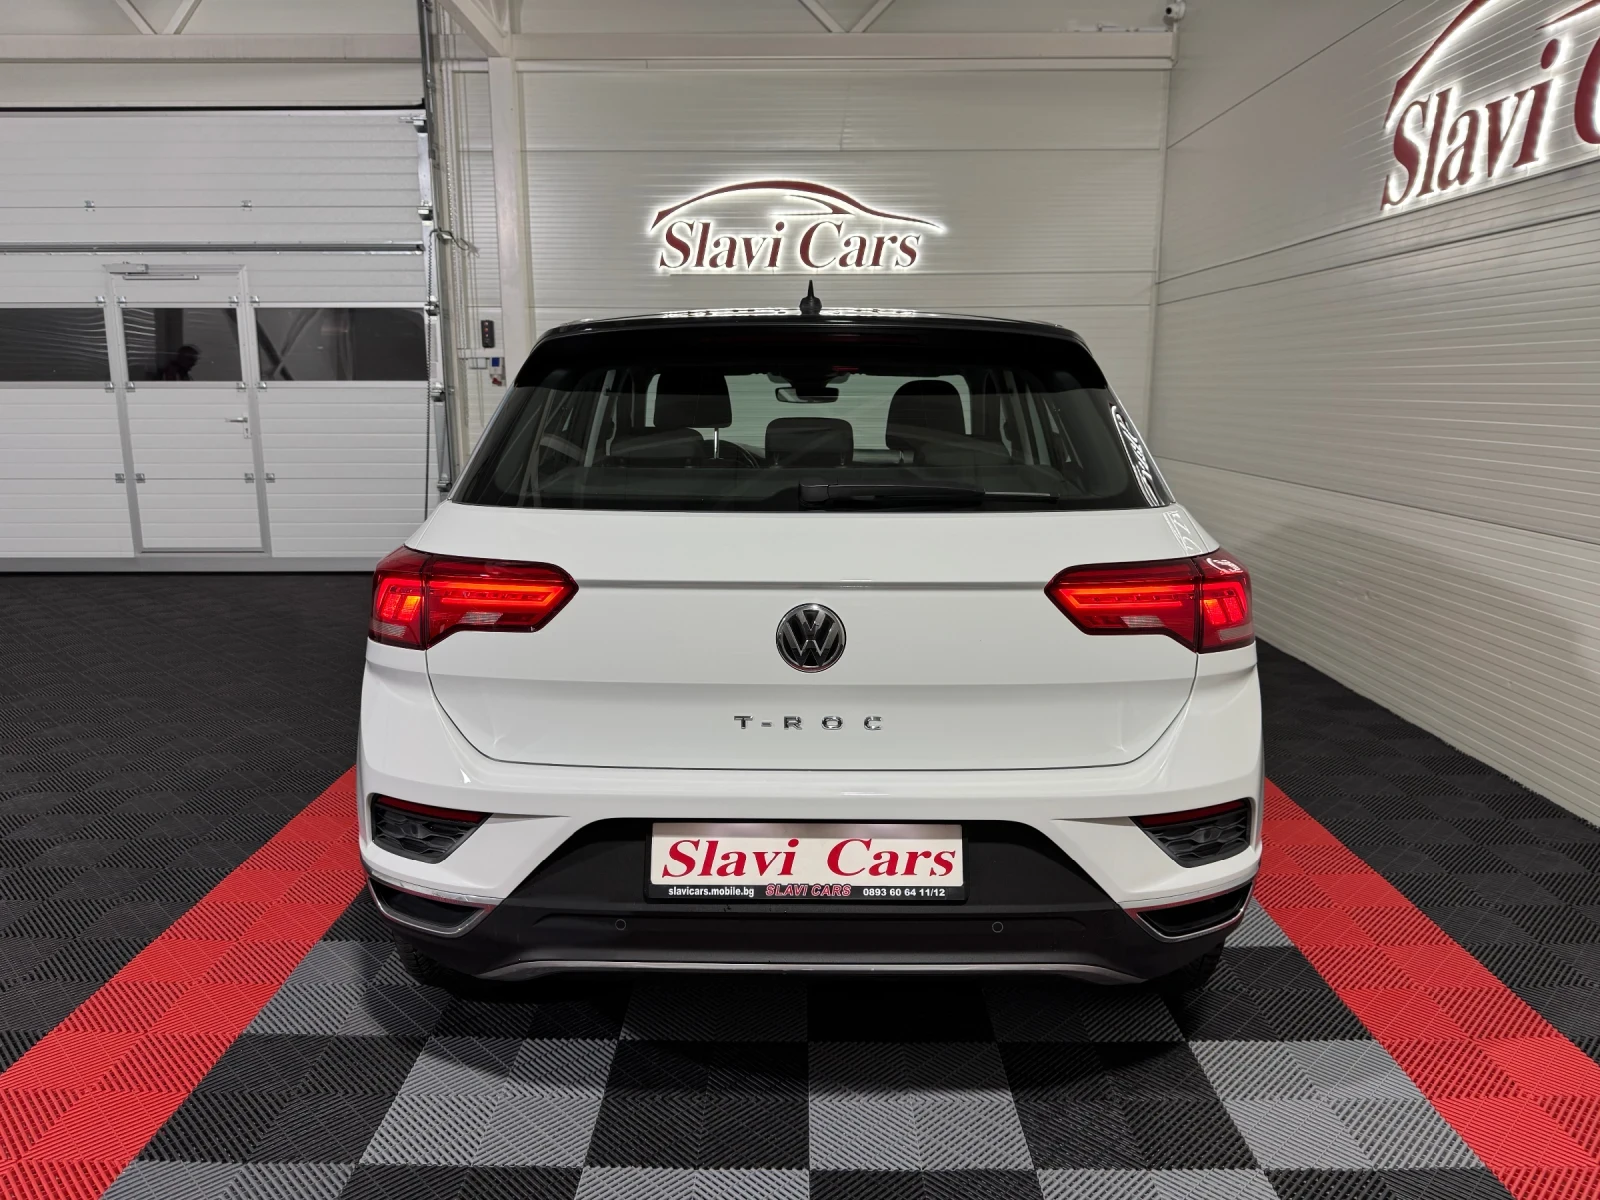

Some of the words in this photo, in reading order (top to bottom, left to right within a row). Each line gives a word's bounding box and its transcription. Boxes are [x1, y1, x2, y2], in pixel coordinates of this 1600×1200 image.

[1380, 38, 1555, 211] Slavi
[658, 220, 785, 269] Slavi
[799, 220, 922, 269] Cars
[779, 606, 844, 670] VW
[733, 715, 885, 731] T-ROC
[661, 838, 800, 878] Slavi
[826, 838, 956, 877] Cars
[668, 886, 755, 898] slavicars.mobile.bg
[765, 883, 808, 897] SLAVI
[810, 884, 852, 897] CARS
[862, 888, 887, 897] 0893
[889, 888, 902, 897] 60
[904, 888, 917, 897] 64
[918, 888, 946, 897] 11/12
